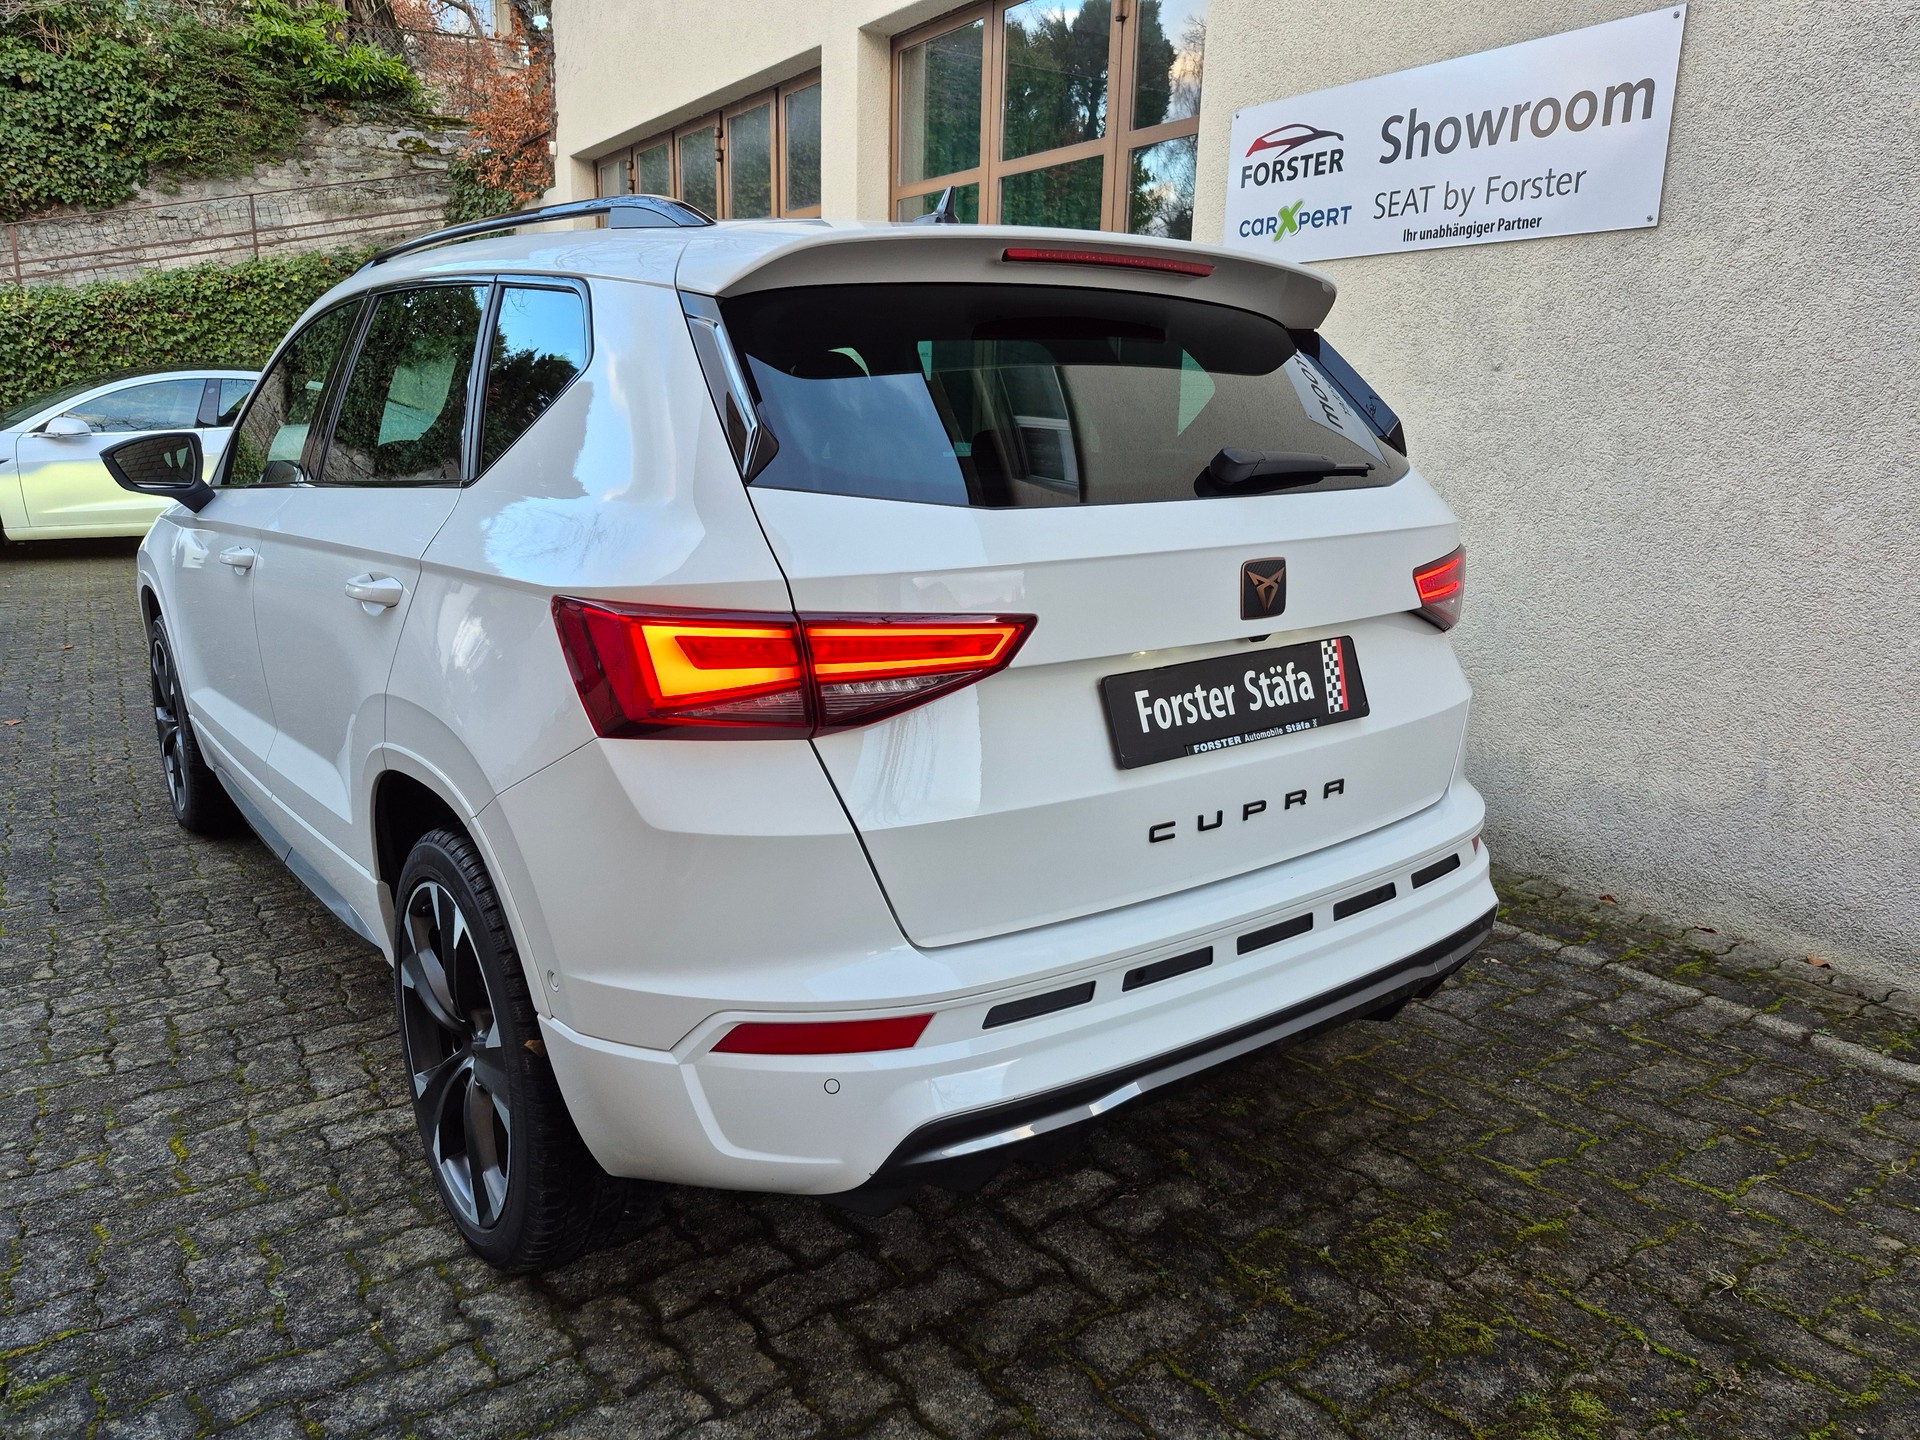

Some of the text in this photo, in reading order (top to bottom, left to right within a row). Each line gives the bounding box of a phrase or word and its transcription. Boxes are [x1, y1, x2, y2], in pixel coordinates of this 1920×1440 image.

[1379, 77, 1656, 165] Showroom
[1240, 148, 1344, 189] FORSTER
[1373, 167, 1588, 220] SEAT by Forster
[1402, 215, 1543, 243] Ihr unabhängiger Partner
[1134, 661, 1315, 734] Forster Stäfa
[1193, 720, 1311, 754] FORSTER Automobile Stäfa
[1148, 777, 1345, 844] CUPRA
